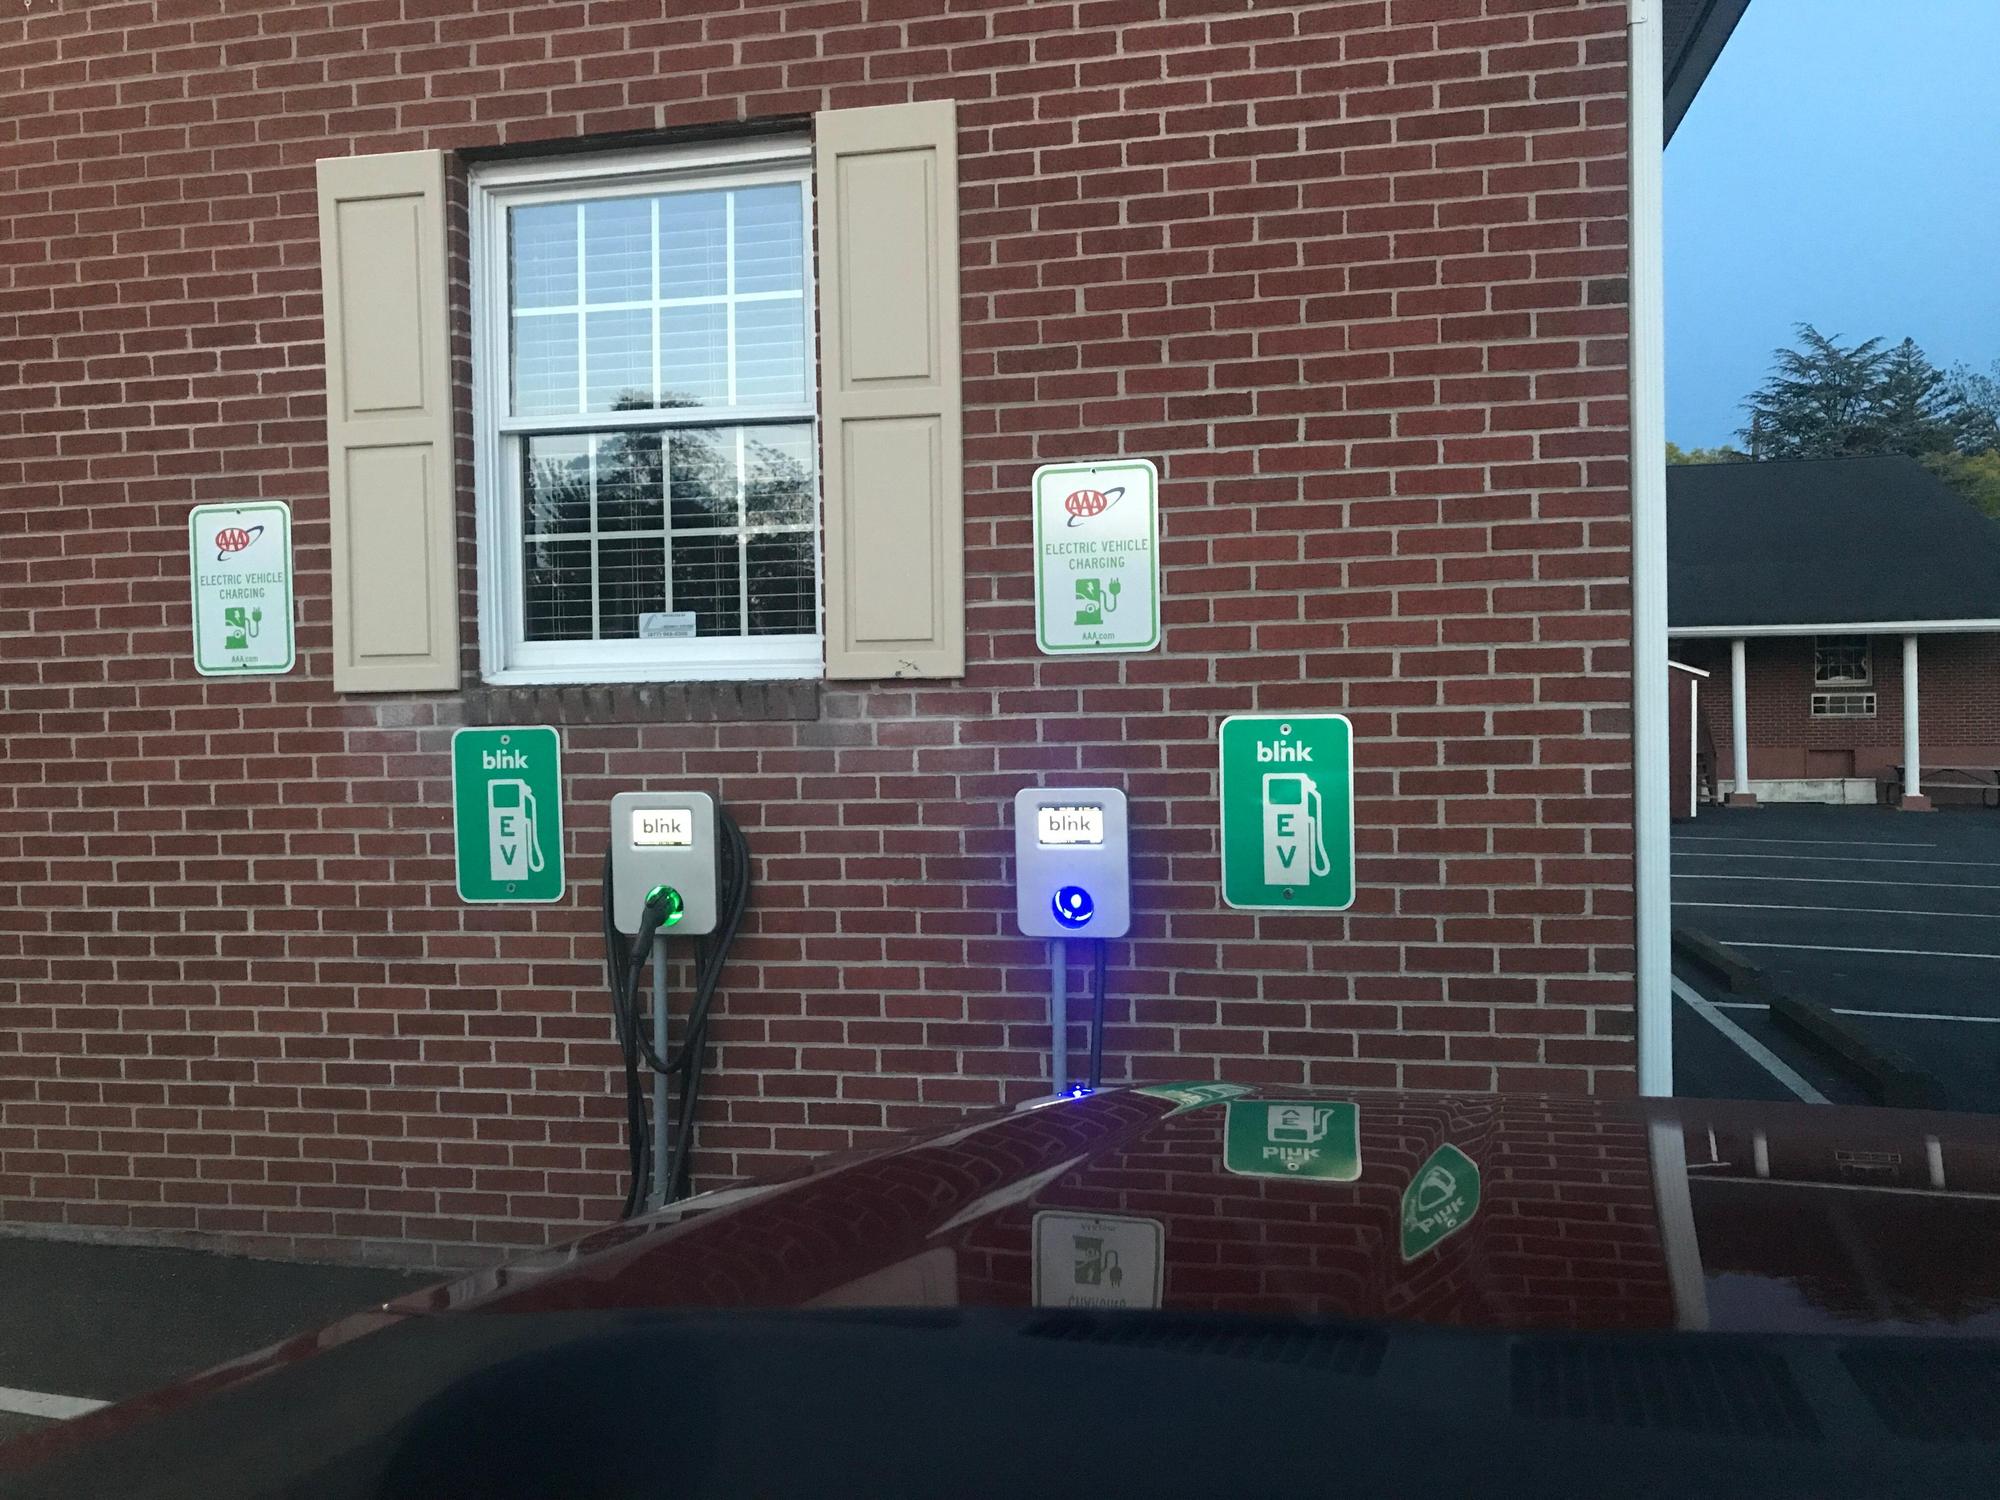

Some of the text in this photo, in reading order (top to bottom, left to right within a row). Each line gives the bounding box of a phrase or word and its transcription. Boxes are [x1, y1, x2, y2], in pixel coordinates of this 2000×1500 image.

[1069, 491, 1104, 515] AAA
[218, 528, 247, 551] AAA
[1046, 539, 1148, 555] ELECTRIC VEHICLE
[1069, 556, 1125, 570] CHARGING
[200, 572, 283, 586] ELECTRIC VEHICLE
[219, 588, 265, 600] CHARGING
[1082, 632, 1115, 640] AAA.com
[482, 749, 528, 769] blink
[1257, 741, 1313, 762] blink
[643, 817, 681, 833] blink
[1049, 815, 1091, 831] blink
